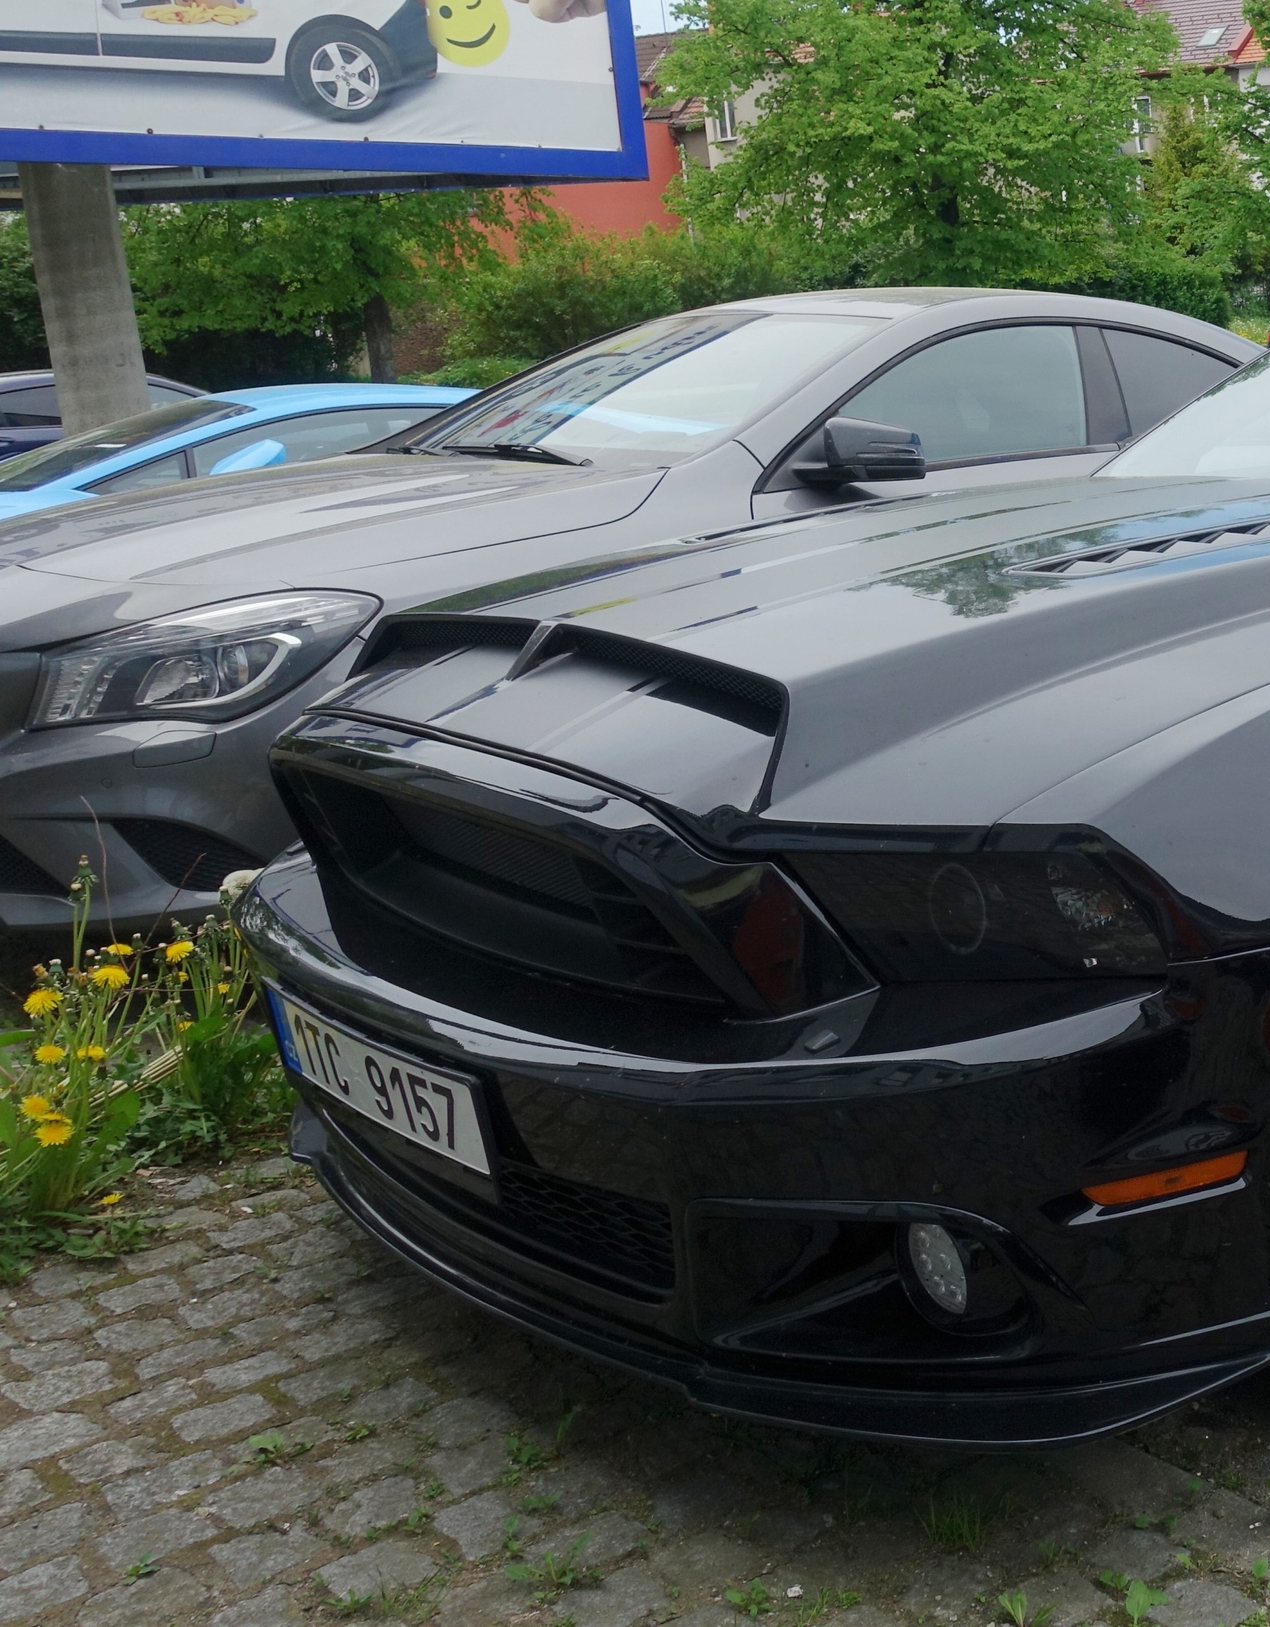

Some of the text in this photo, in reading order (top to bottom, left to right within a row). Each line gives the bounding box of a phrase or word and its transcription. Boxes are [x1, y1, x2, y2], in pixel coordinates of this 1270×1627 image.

[284, 1039, 299, 1062] CZ
[294, 1013, 456, 1150] 1TC 9157
